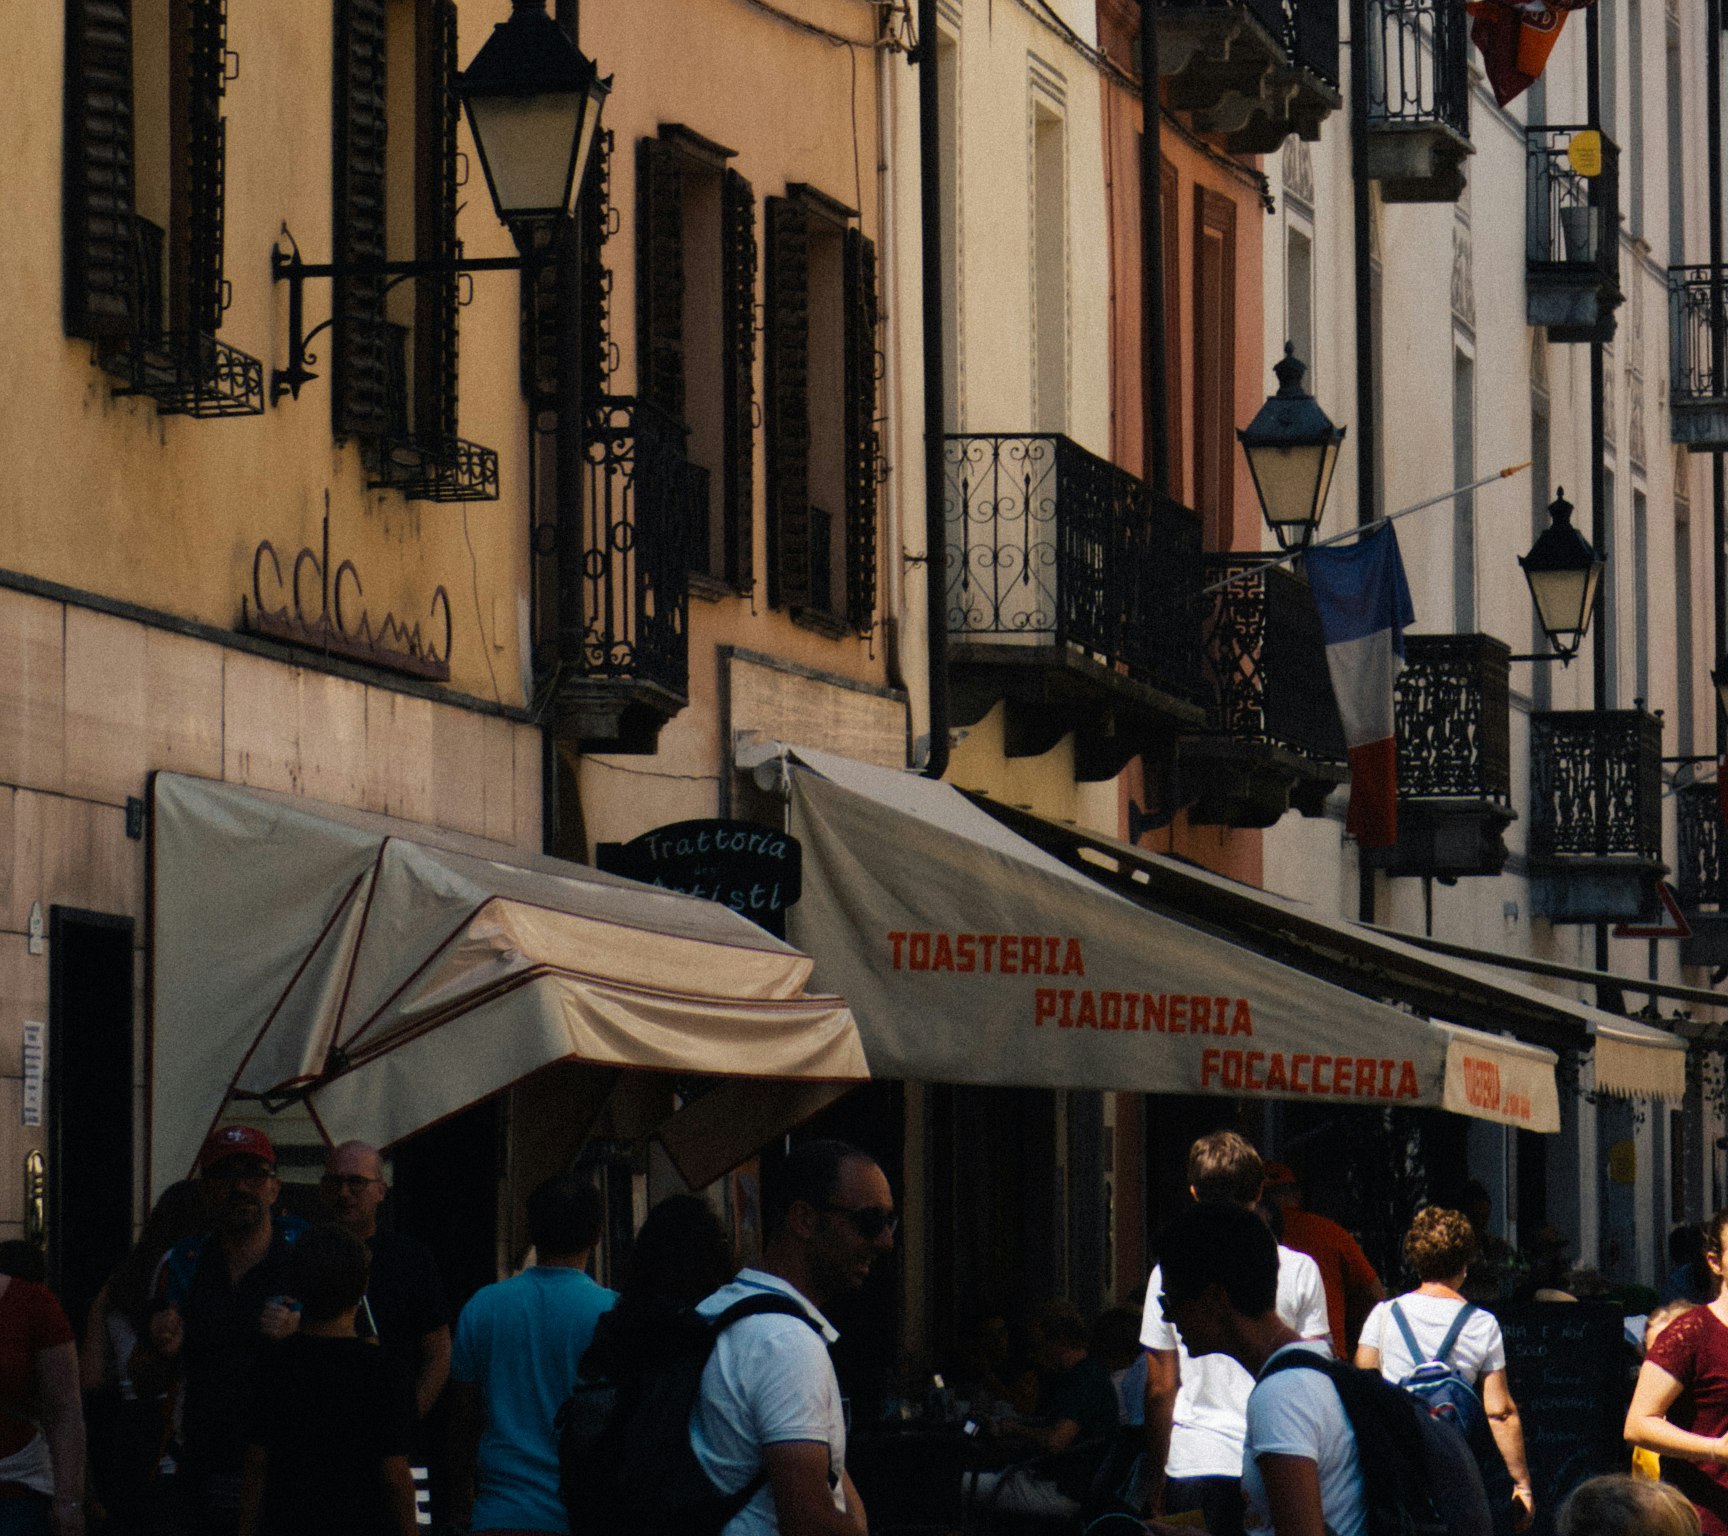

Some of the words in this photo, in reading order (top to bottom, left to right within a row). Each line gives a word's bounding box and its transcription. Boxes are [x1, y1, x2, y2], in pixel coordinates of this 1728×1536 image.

[644, 828, 787, 861] Trattoria
[887, 931, 1085, 977] TOASTERIA
[1035, 988, 1254, 1037] PIADINERIA
[1201, 1049, 1421, 1099] FOCACCERIA
